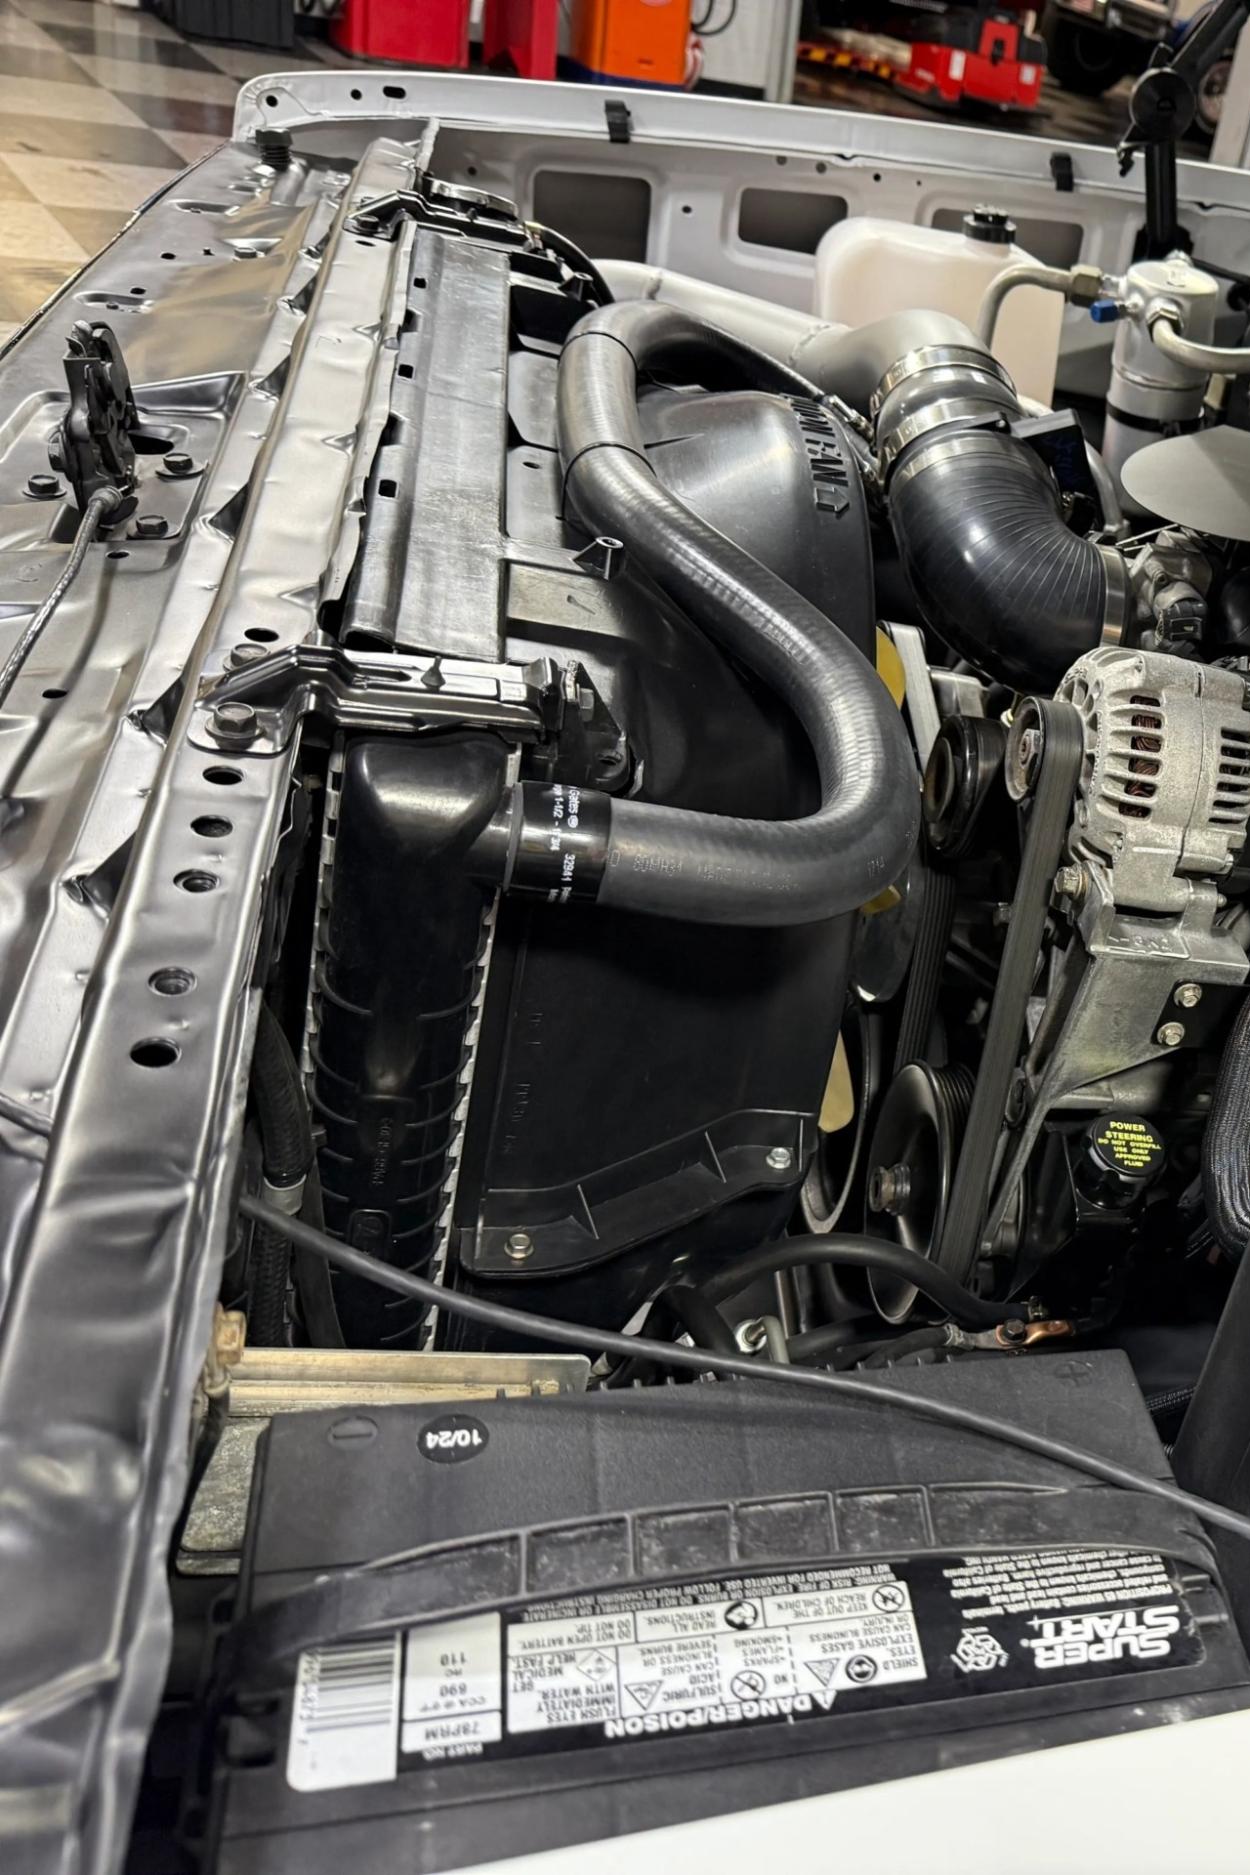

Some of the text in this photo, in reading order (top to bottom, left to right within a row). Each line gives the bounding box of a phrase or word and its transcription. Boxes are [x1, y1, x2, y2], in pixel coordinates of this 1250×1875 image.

[551, 796, 565, 818] 1-1/2
[566, 788, 581, 814] Gates
[558, 852, 577, 882] 32941
[1110, 1121, 1145, 1132] POWER
[1105, 1131, 1153, 1142] STEERING
[1130, 1141, 1162, 1150] OVERFILL
[1115, 1153, 1151, 1161] APPROVED
[425, 1428, 482, 1448] 10/24
[822, 1595, 833, 1606] OF
[834, 1592, 866, 1603] REACH
[791, 1601, 868, 1619] KEEP OUT OF THE
[615, 1618, 630, 1628] DO
[892, 1613, 909, 1623] OR
[593, 1620, 613, 1631] NOT
[616, 1627, 631, 1637] DO
[672, 1619, 716, 1632] READ ALL
[808, 1622, 912, 1642] CAN CAUSE BLINDNESS
[1027, 1606, 1180, 1646] START
[565, 1632, 592, 1643] OPEN
[594, 1629, 614, 1640] NOT
[674, 1640, 712, 1651] SEVERE
[820, 1634, 913, 1652] EXPLOSIVE GASES
[886, 1644, 915, 1657] EYES.
[1032, 1632, 1171, 1668] SUPER
[438, 1651, 466, 1665] 110
[547, 1651, 575, 1664] HELP
[642, 1651, 713, 1667] BLINDNESS OR
[882, 1657, 918, 1669] SHIELD
[511, 1665, 563, 1679] MEDICAL
[660, 1661, 714, 1674] CAN CAUSE
[688, 1672, 715, 1685] ACID
[772, 1673, 788, 1684] NO
[511, 1680, 532, 1692] GET
[584, 1683, 615, 1694] WITH
[661, 1687, 716, 1700] SULFURIC
[457, 1695, 486, 1707] CCA
[535, 1694, 616, 1711] IMMEDIATELY
[546, 1706, 616, 1723] FLUSH EYES
[604, 1693, 813, 1739] DANGER/POISON
[422, 1722, 480, 1739] 78PRM
